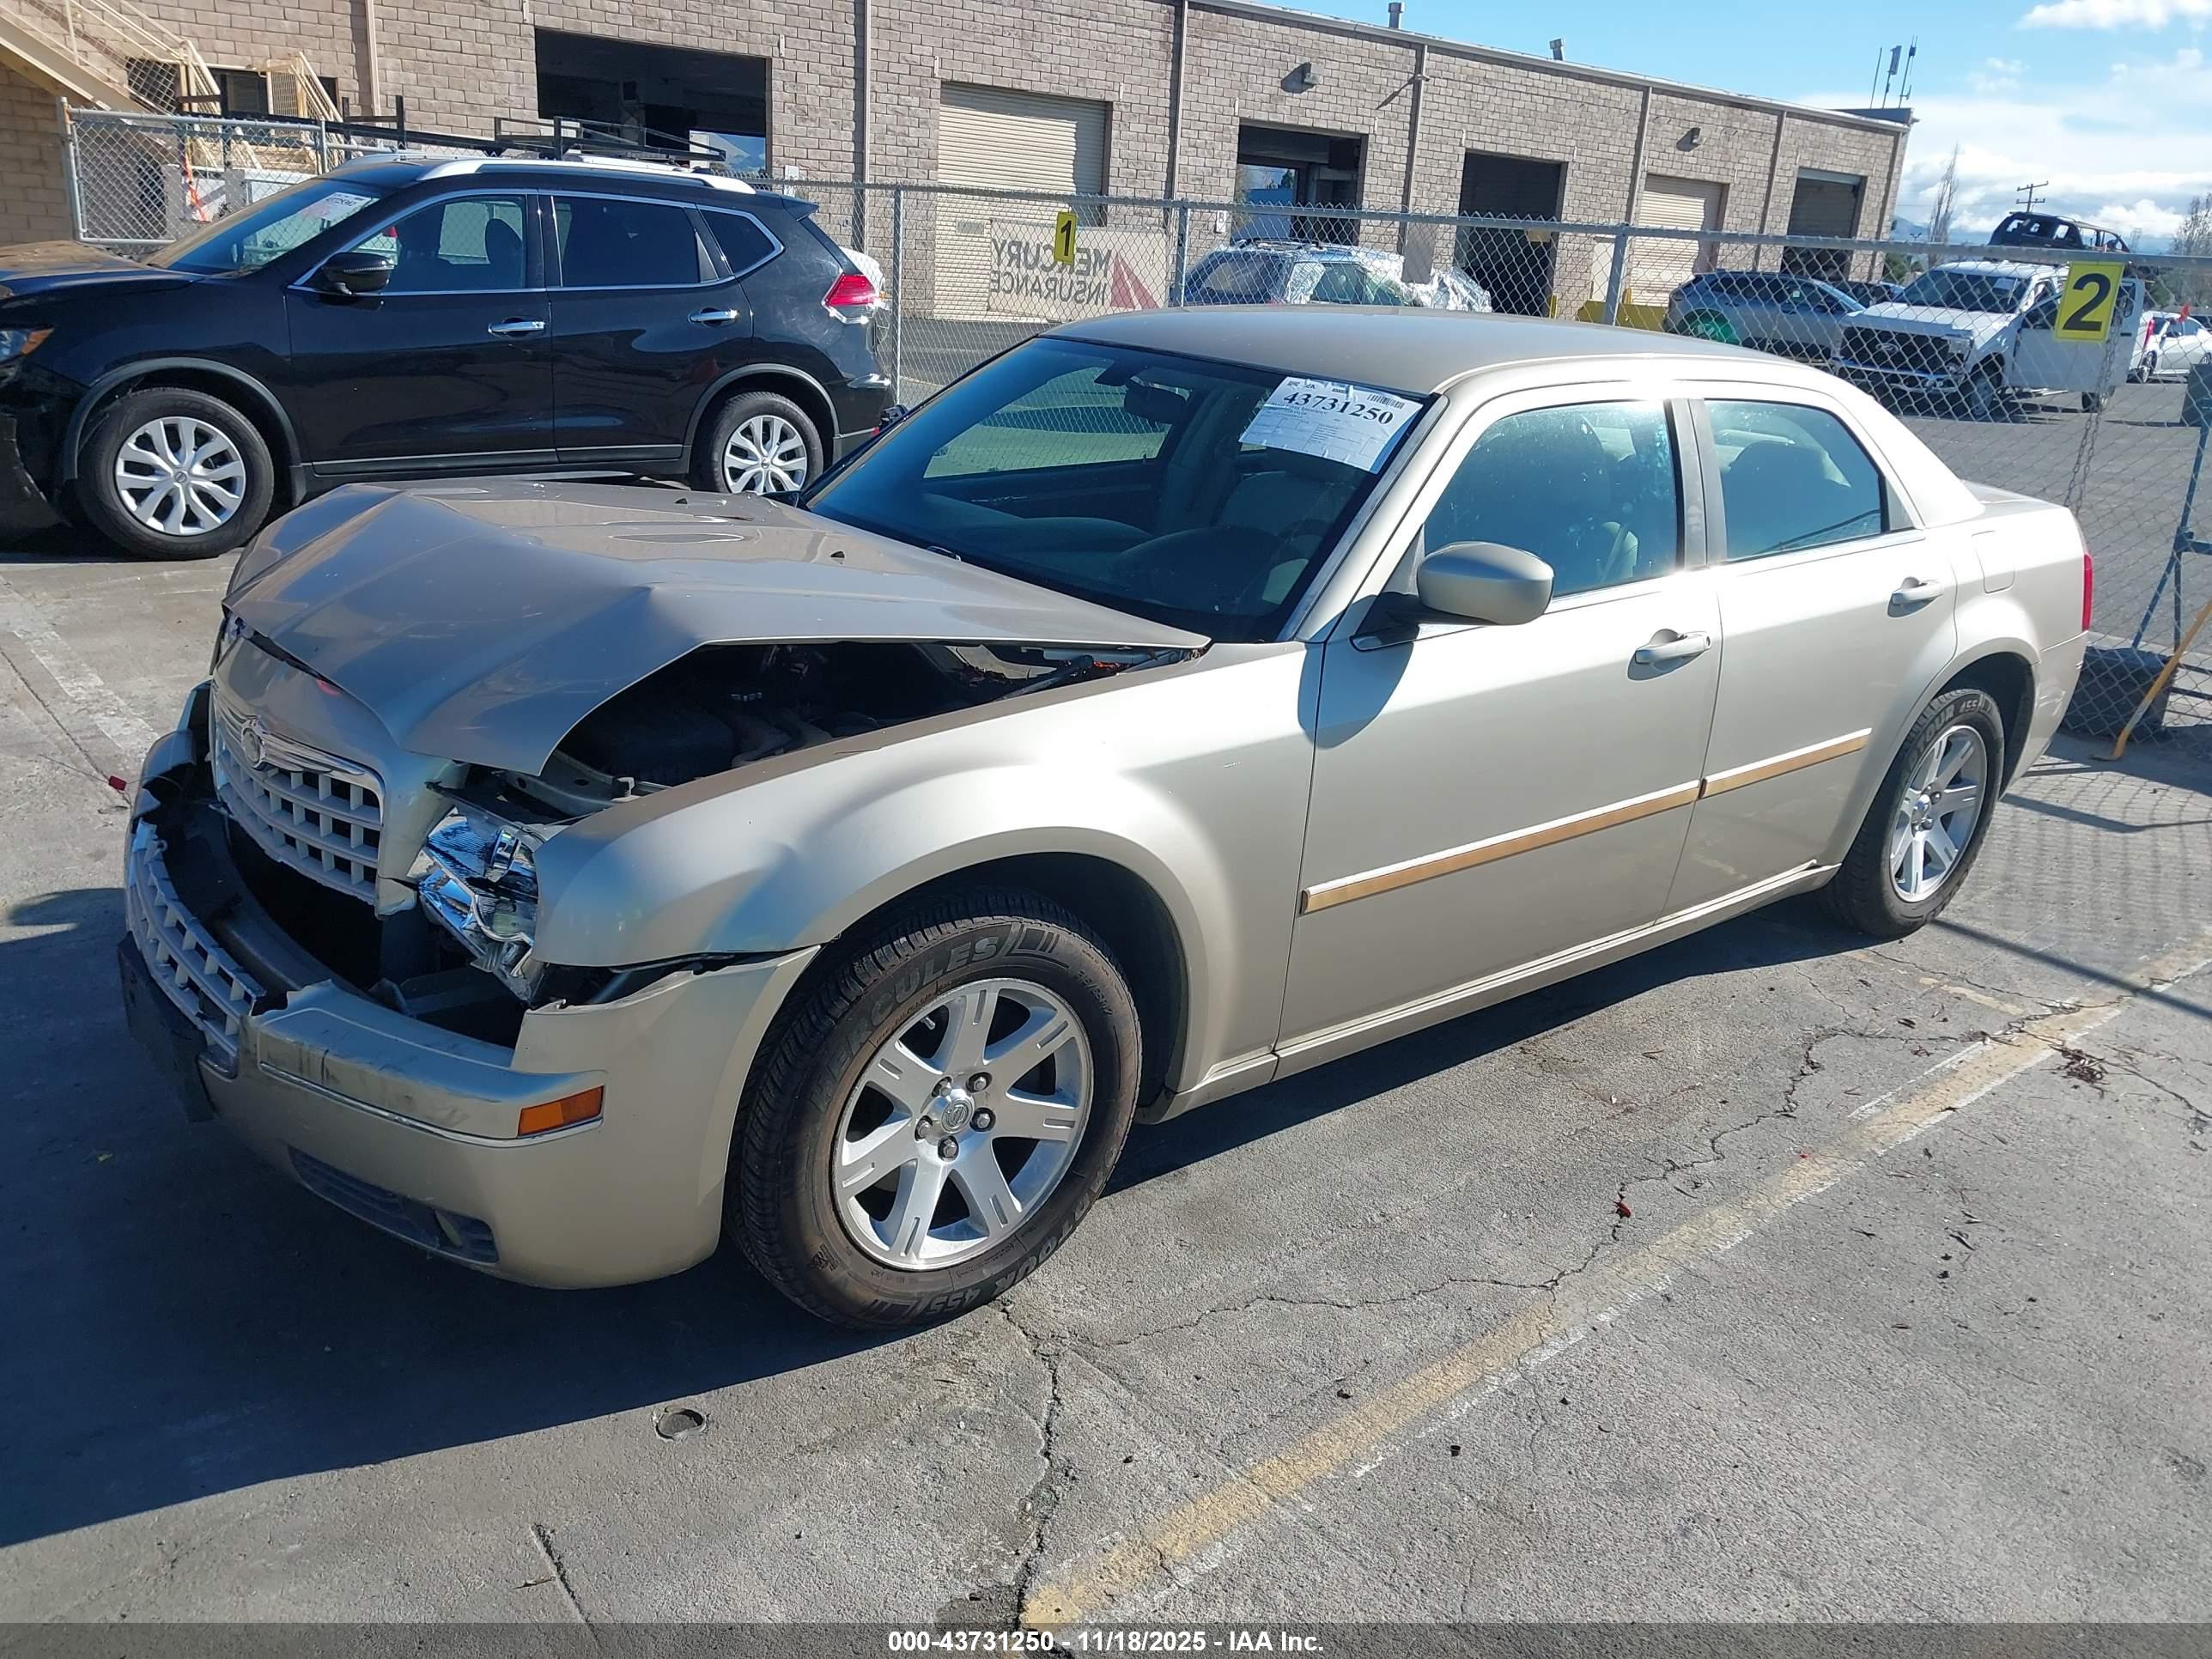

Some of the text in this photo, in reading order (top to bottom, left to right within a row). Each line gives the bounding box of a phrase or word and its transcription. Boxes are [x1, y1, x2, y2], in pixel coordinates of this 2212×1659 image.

[1060, 220, 1072, 257] 1
[2063, 272, 2112, 332] 2
[1283, 392, 1395, 425] 43731250
[810, 936, 998, 1114] HERCULES
[927, 1288, 981, 1315] 455
